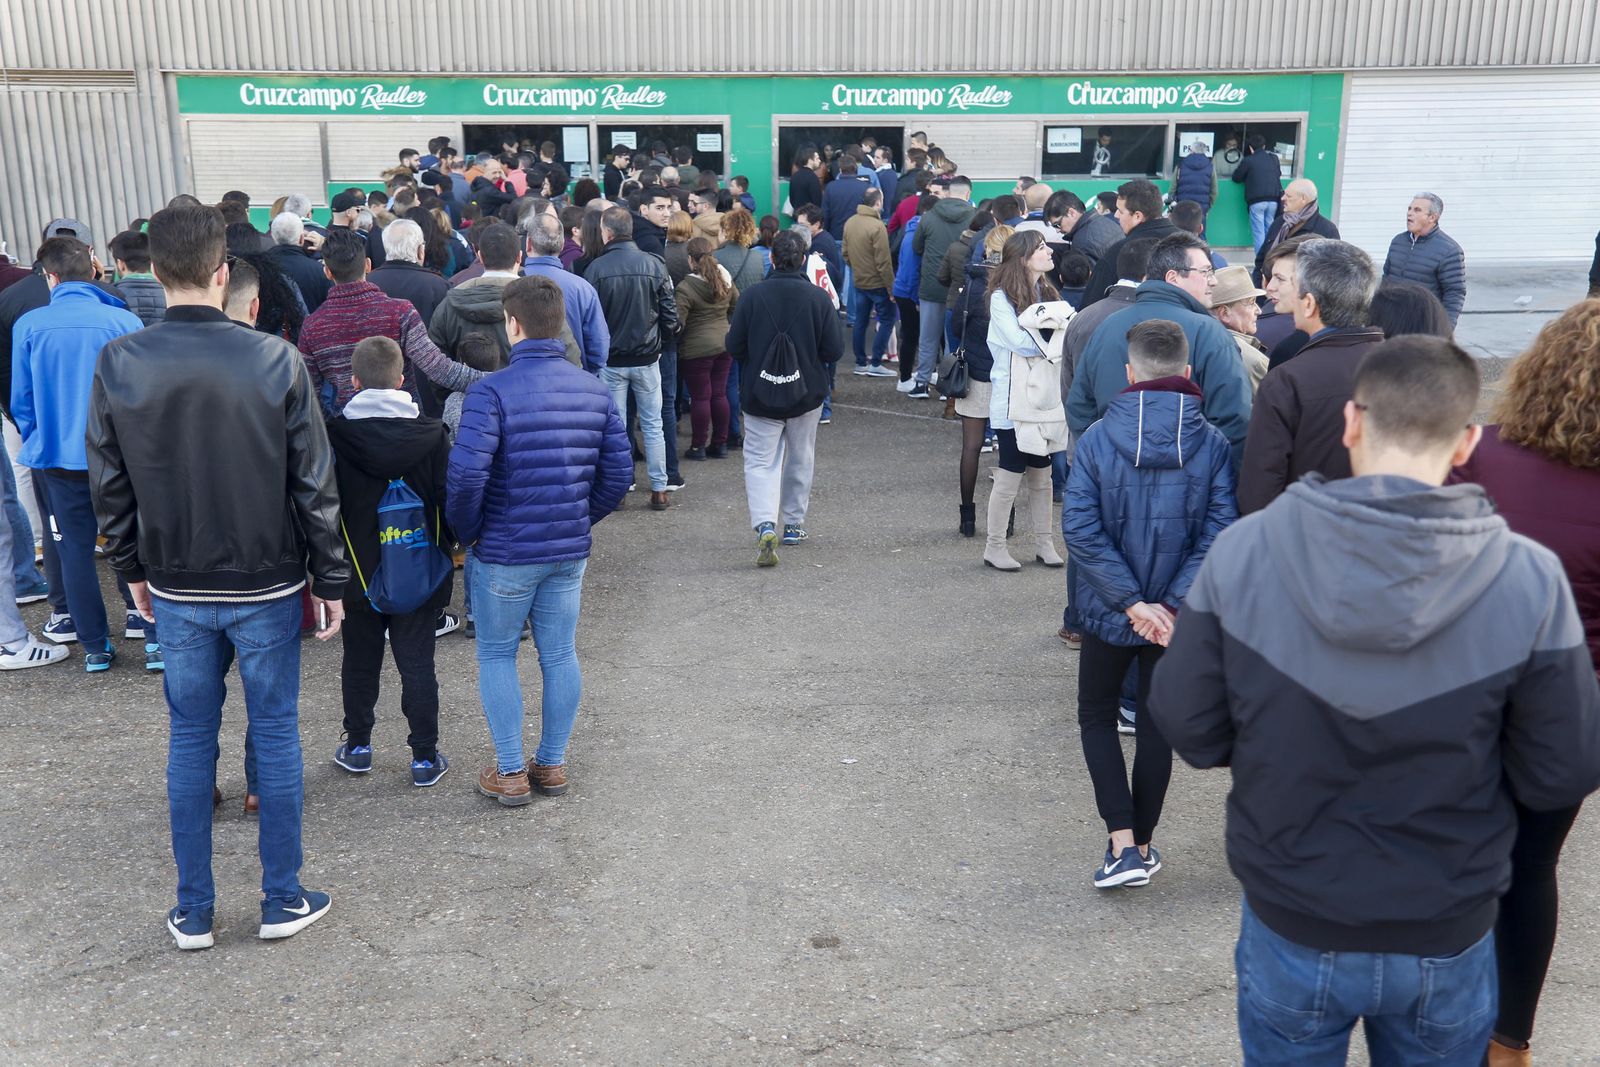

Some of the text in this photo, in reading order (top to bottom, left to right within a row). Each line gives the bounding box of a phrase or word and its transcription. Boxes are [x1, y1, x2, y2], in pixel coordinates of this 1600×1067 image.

[239, 83, 428, 111] Cruzcampo Radler
[483, 83, 668, 111] Cruzcampo Radler
[831, 83, 1014, 110] Cruzcampo Radler
[1067, 81, 1248, 109] Cruzcampo Radler
